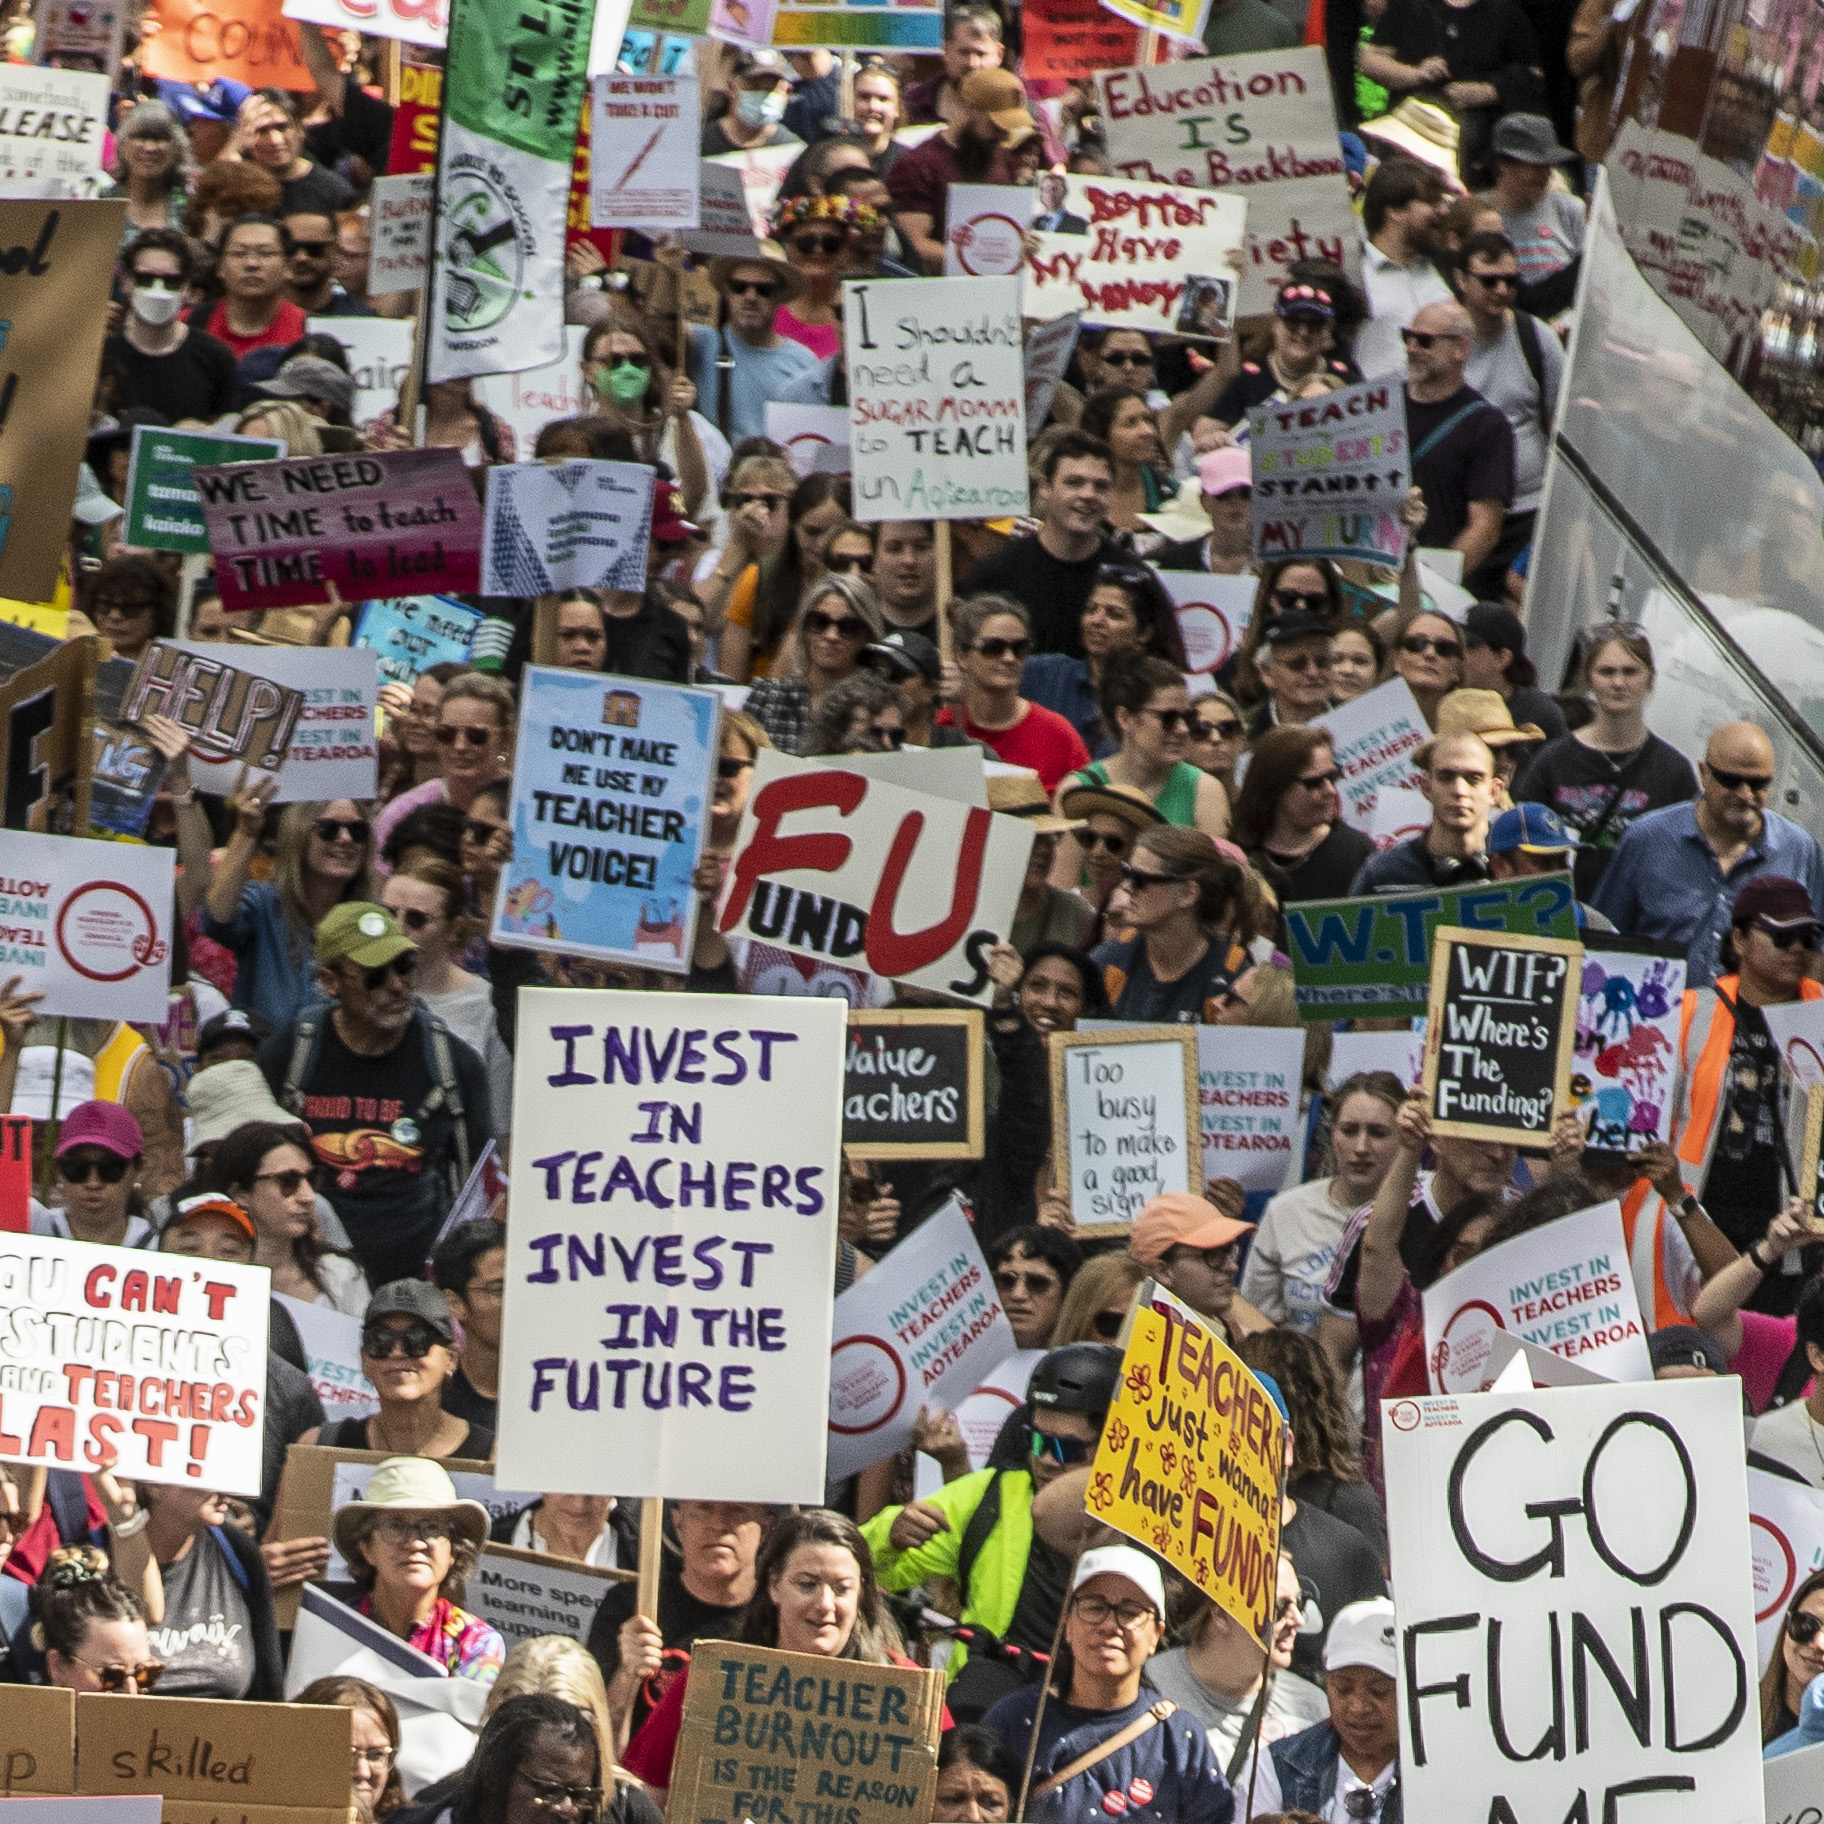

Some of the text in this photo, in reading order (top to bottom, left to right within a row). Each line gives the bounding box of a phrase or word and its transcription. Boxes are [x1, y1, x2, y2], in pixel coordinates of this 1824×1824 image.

[1104, 68, 1306, 119] Education
[1180, 115, 1251, 148] IS
[202, 459, 381, 505] WE NEED
[230, 508, 323, 545] TIME
[377, 499, 458, 531] teach
[551, 727, 678, 765] DON'T MAKE
[562, 764, 669, 797] ME USE MY
[533, 792, 686, 846] TEACHER
[547, 842, 657, 890] VOICE!
[1459, 946, 1566, 997] WTF?
[1447, 1003, 1548, 1050] Where's
[547, 1025, 798, 1087] INVEST
[1076, 1052, 1123, 1085] Too
[1447, 1044, 1503, 1079] The
[632, 1102, 703, 1144] IN
[1097, 1089, 1157, 1131] busy
[1438, 1079, 1552, 1128] Funding?
[1082, 1129, 1175, 1156] to make
[533, 1154, 825, 1215] TEACHERS
[1083, 1168, 1100, 1193] a
[527, 1235, 774, 1289] INVEST
[602, 1304, 786, 1350] IN THE
[531, 1359, 757, 1413] FUTURE
[1447, 1408, 1698, 1586] GO
[720, 1661, 911, 1724] TEACHER
[1405, 1603, 1748, 1767] FUND
[715, 1711, 913, 1774] BURNOUT
[712, 1760, 917, 1808] IS THE REASON
[733, 1790, 789, 1819] FOR
